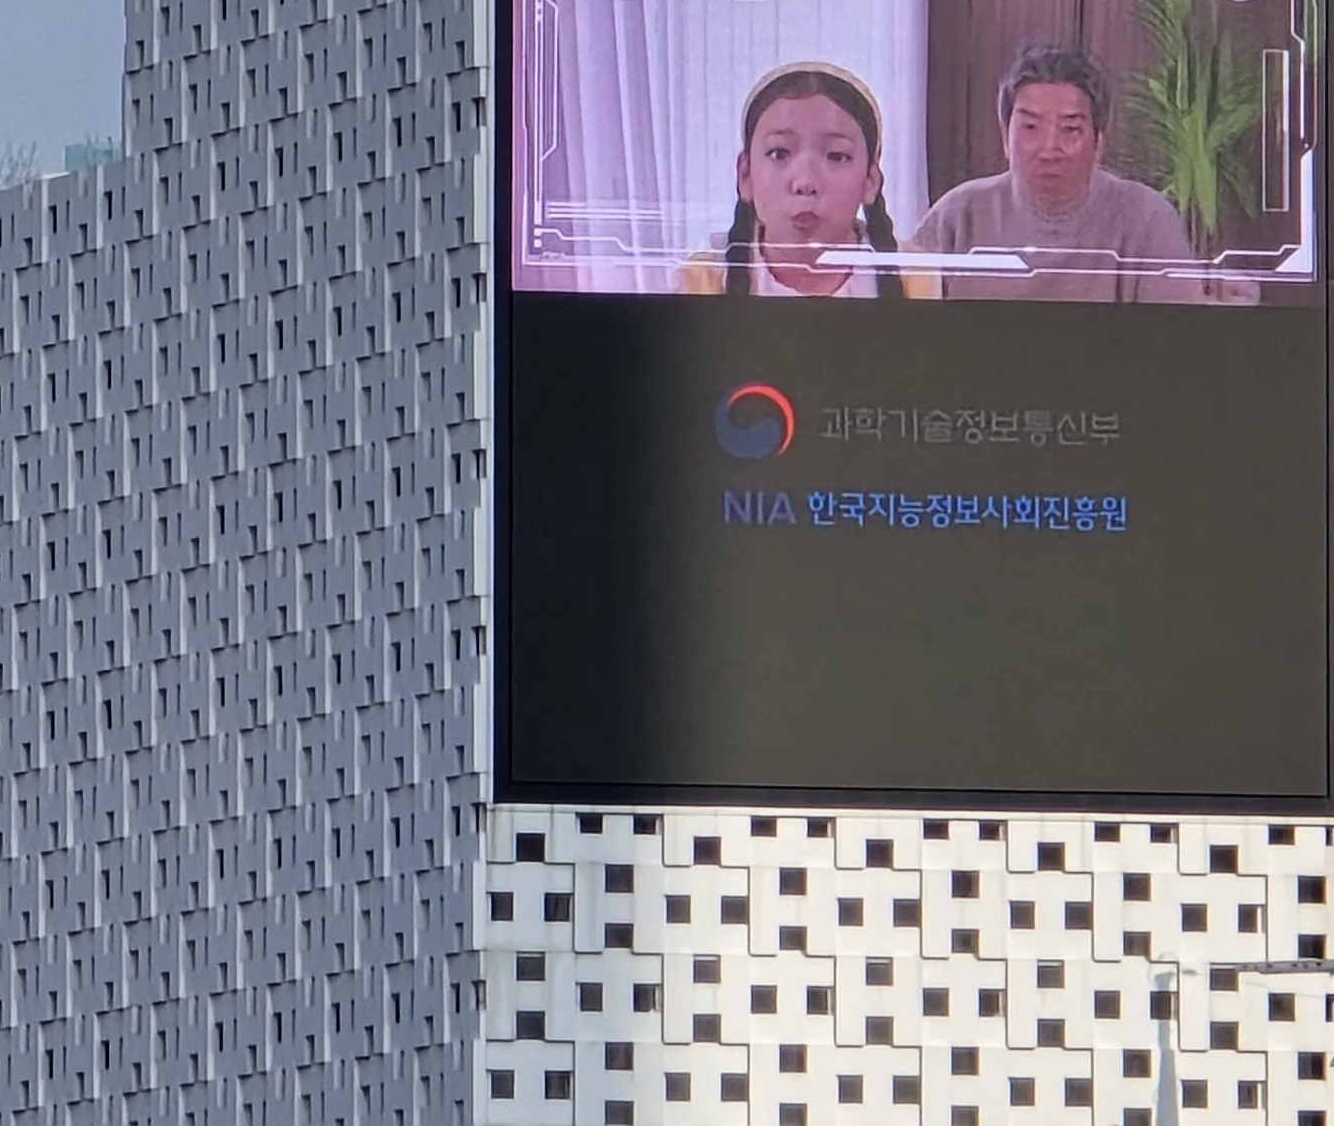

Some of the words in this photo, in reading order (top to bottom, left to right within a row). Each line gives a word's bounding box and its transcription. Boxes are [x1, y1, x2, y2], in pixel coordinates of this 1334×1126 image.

[820, 407, 1120, 446] 과학기술정보통신부
[724, 491, 796, 525] NIA
[808, 491, 1127, 531] 한국지능정보사회진흥원
